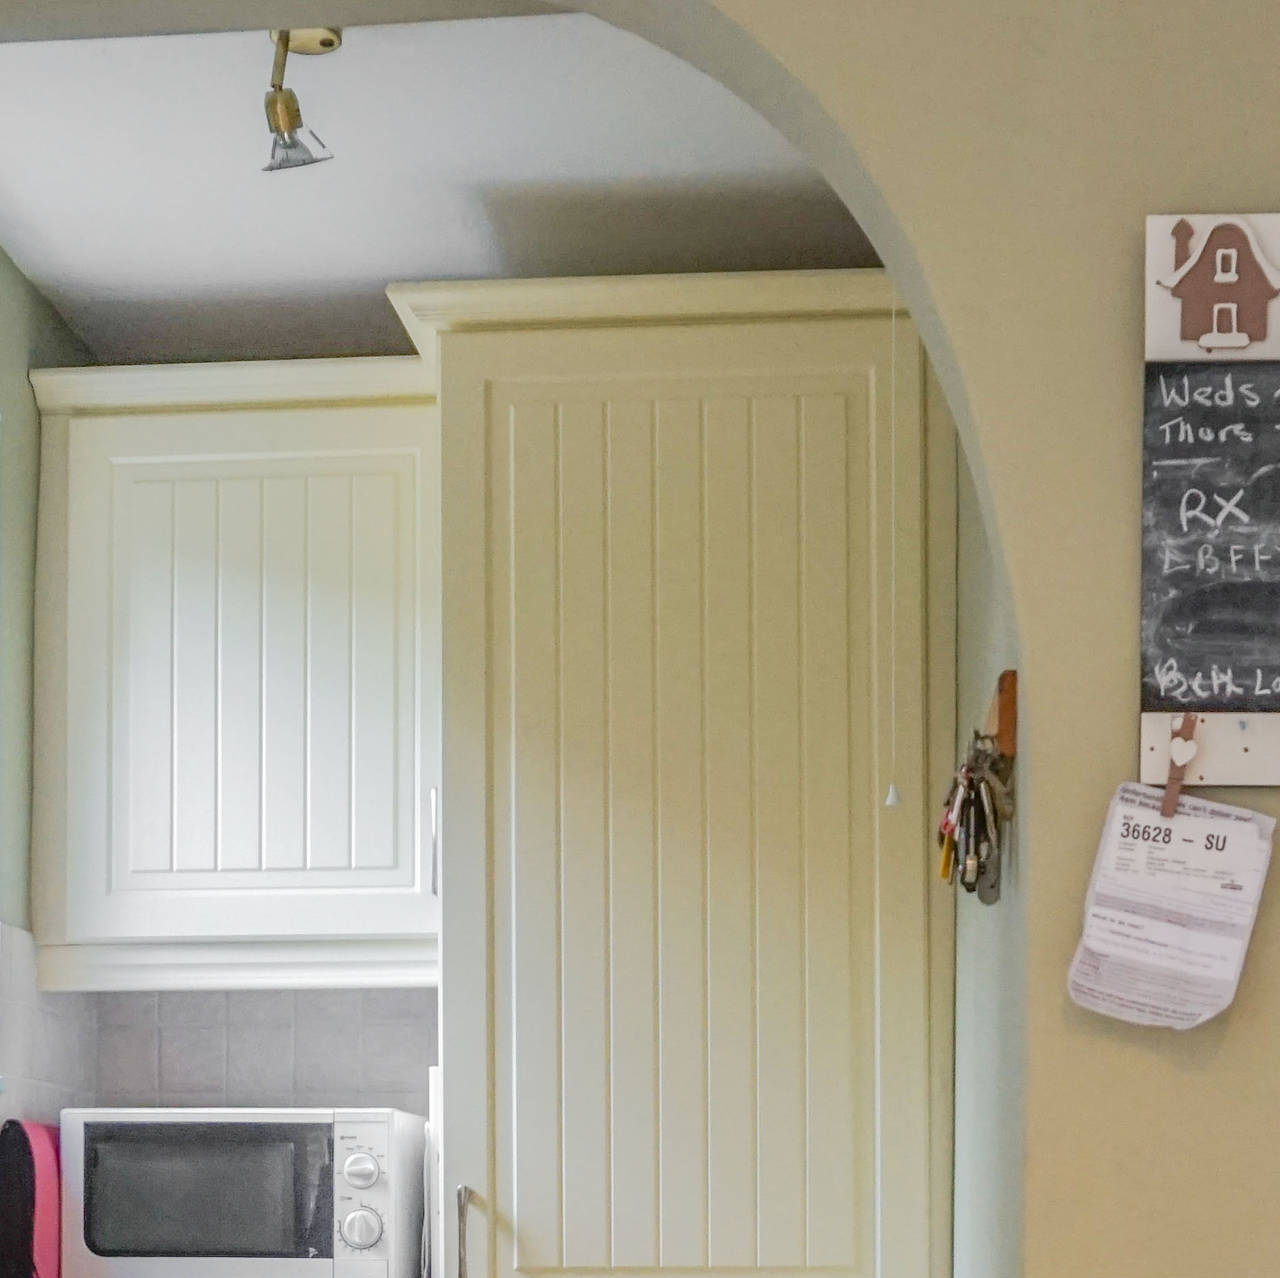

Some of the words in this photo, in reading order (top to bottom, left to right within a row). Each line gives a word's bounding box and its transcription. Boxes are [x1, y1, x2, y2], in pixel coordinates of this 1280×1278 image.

[1159, 372, 1261, 408] Weds
[1120, 822, 1172, 845] 36628
[1204, 833, 1227, 852] SU
